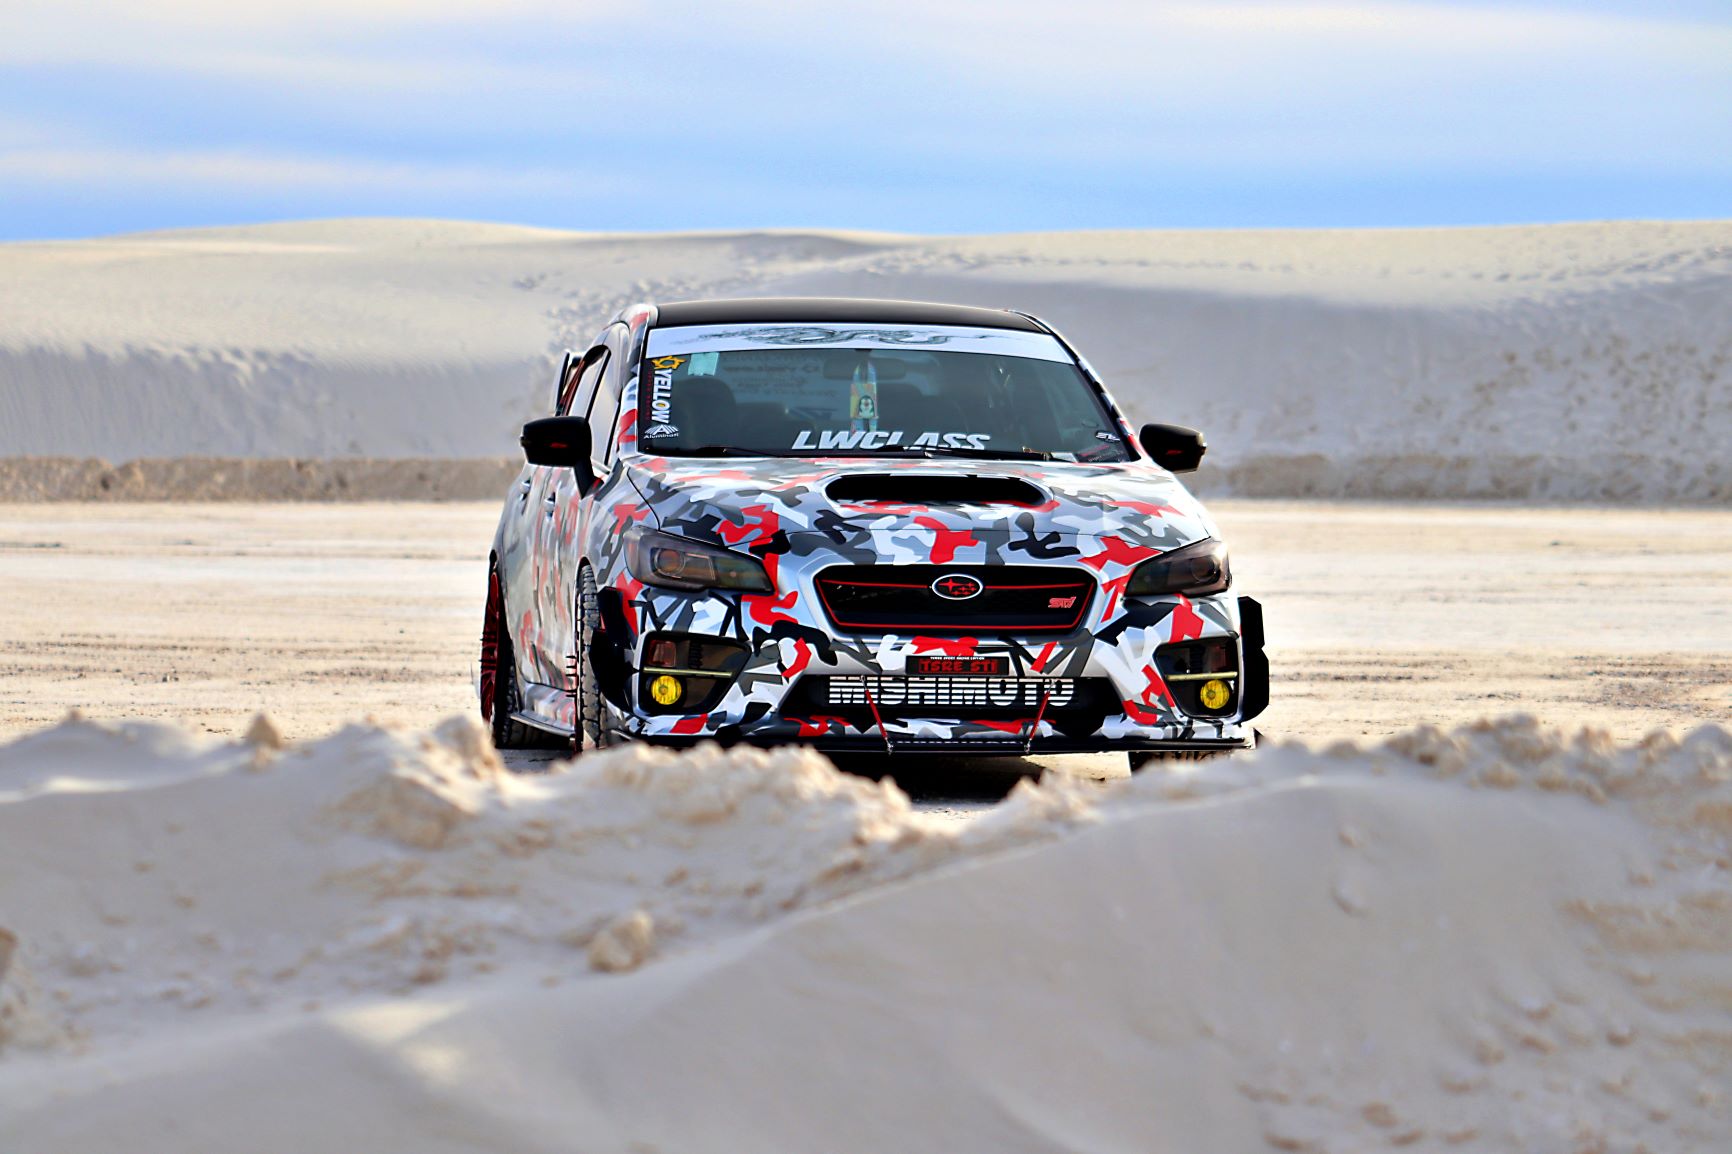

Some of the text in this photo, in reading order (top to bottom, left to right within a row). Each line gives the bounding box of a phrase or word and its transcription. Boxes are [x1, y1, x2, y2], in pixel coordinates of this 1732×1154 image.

[652, 369, 673, 423] YELLOW
[791, 430, 991, 451] LWCLASS
[970, 661, 998, 673] STI
[829, 676, 1075, 707] MISHIMOTO
